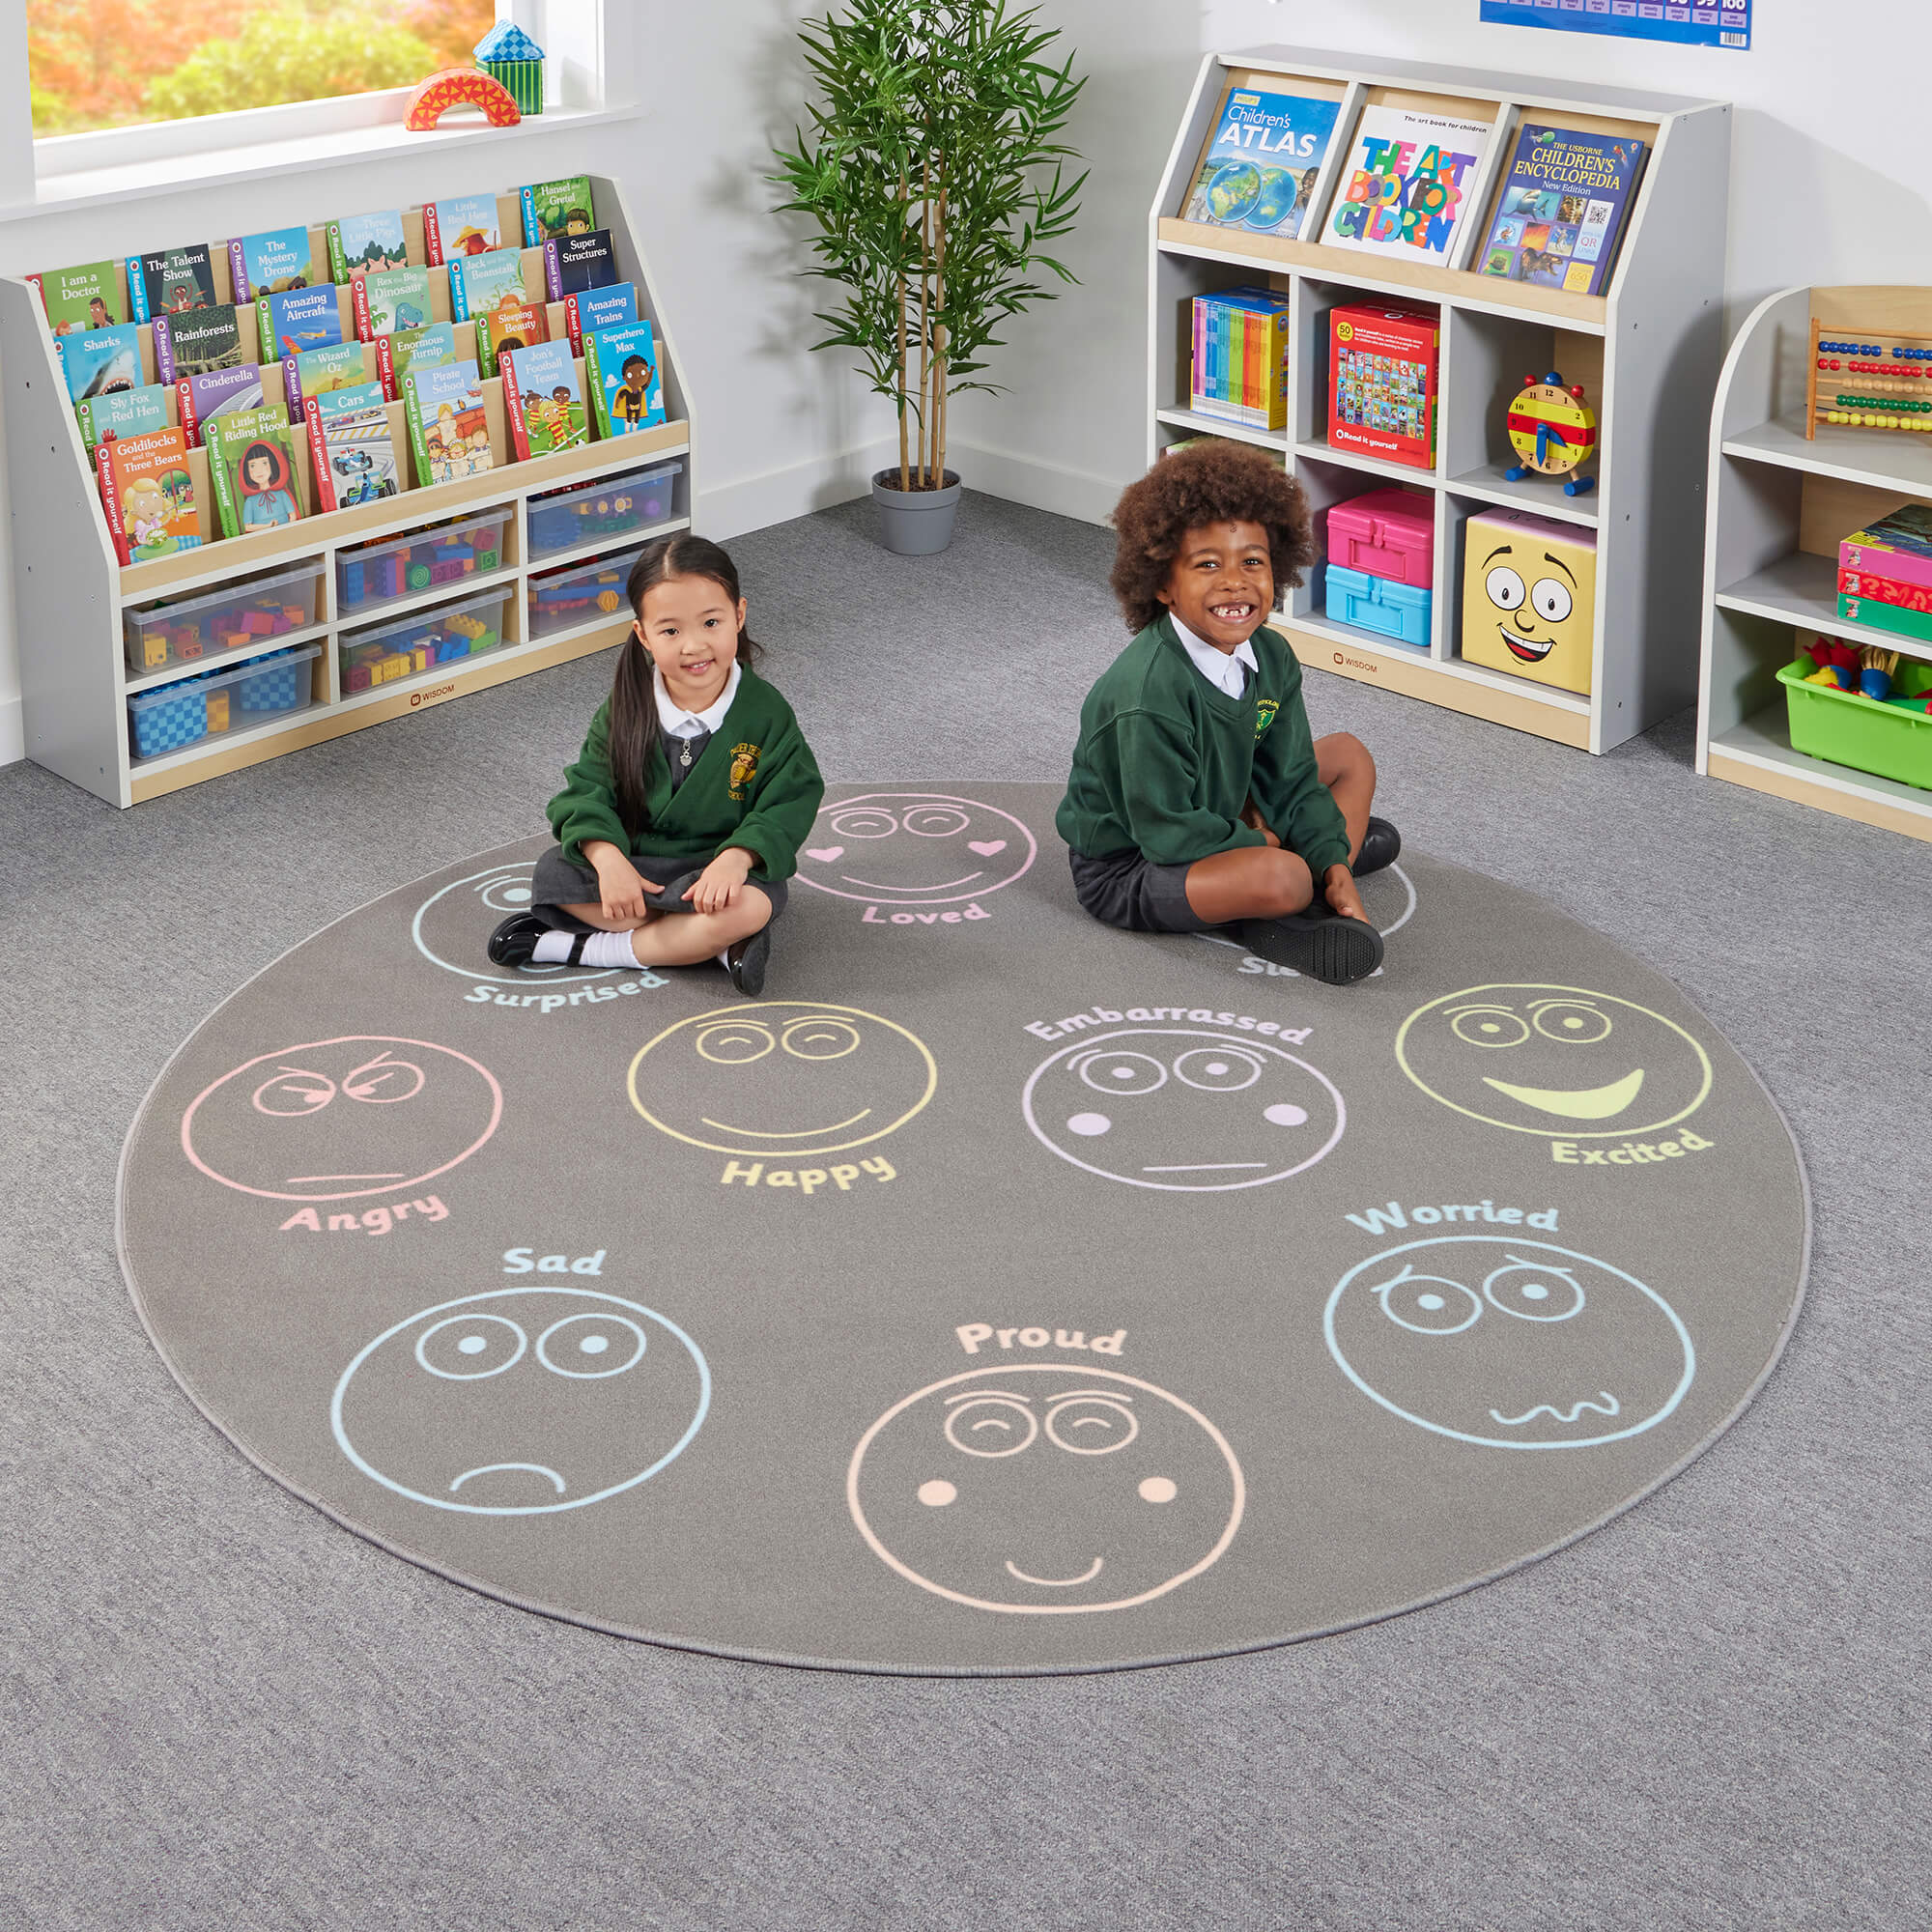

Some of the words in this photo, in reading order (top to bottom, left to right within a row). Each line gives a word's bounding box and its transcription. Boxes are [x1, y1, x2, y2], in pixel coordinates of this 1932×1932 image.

[1228, 105, 1291, 128] Children's
[1460, 124, 1488, 133] children
[1218, 122, 1318, 157] ATLAS
[1553, 142, 1567, 151] THE
[1569, 144, 1604, 156] USBORNE
[1362, 136, 1417, 176] THE
[1412, 145, 1478, 187] ART
[1532, 147, 1615, 174] CHILDREN'S
[1515, 160, 1621, 190] ENCYCLOPEDIA
[541, 183, 570, 196] Hansel
[1345, 170, 1420, 209] BOOK
[1409, 178, 1463, 222] FOR
[1542, 181, 1561, 191] New
[1562, 184, 1591, 195] Edition
[455, 201, 478, 213] Little
[549, 193, 576, 205] Gretel
[448, 213, 466, 224] Red
[429, 218, 439, 240] Read
[265, 242, 286, 253] The
[332, 238, 342, 259] Read
[570, 238, 597, 251] Super
[1580, 237, 1598, 247] QR
[147, 259, 169, 272] The
[171, 253, 205, 267] Talent
[258, 252, 298, 267] Mystery
[466, 259, 486, 270] Jack
[562, 247, 607, 263] Structures
[234, 255, 243, 276] Read
[264, 265, 296, 278] Drone
[471, 263, 515, 280] Beanstalk
[62, 276, 66, 288] I
[70, 276, 87, 286] am
[91, 273, 97, 282] a
[132, 272, 142, 296] Read
[162, 269, 193, 282] Show
[377, 276, 393, 287] Rex
[403, 272, 417, 282] Big
[454, 274, 463, 296] Read
[62, 286, 100, 301] Doctor
[375, 284, 423, 299] Dinosaur
[282, 294, 327, 310] Amazing
[357, 294, 367, 315] Read
[587, 297, 628, 312] Amazing
[286, 306, 326, 322] Aircraft
[498, 311, 533, 325] Sleeping
[594, 311, 623, 326] Trains
[175, 321, 235, 343] Rainforests
[263, 313, 271, 336] Read
[504, 319, 537, 334] Beauty
[1339, 325, 1350, 334] 50
[83, 336, 121, 352] Sharks
[159, 332, 169, 356] Read
[397, 334, 444, 352] Enormous
[603, 328, 645, 344] Superhero
[317, 350, 350, 363] Wizard
[411, 346, 442, 359] Turnip
[530, 349, 554, 360] Jon's
[615, 342, 636, 354] Max
[327, 361, 342, 373] Oz
[381, 352, 390, 373] Read
[526, 359, 563, 375] Football
[199, 371, 253, 390] Cinderella
[289, 372, 298, 394] Read
[433, 369, 460, 383] Pirate
[533, 373, 559, 385] Team
[587, 348, 597, 370] Read
[592, 378, 605, 411] yourself
[432, 379, 465, 395] School
[110, 398, 128, 410] Sly
[129, 394, 149, 404] Fox
[182, 396, 193, 419] Read
[338, 394, 365, 409] Cars
[408, 388, 417, 412] Read
[504, 367, 514, 389] Read
[509, 400, 524, 433] yourself
[112, 411, 133, 423] Red
[136, 405, 159, 417] Hen
[232, 416, 256, 429] Little
[259, 410, 276, 422] Red
[83, 417, 92, 441] Read
[224, 427, 257, 442] Riding
[259, 419, 288, 434] Hood
[309, 413, 319, 437] Read
[117, 435, 177, 456] Goldilocks
[412, 421, 426, 456] yourself
[1345, 430, 1362, 442] Read
[1362, 434, 1368, 444] it
[1369, 438, 1398, 450] yourself
[211, 437, 220, 460] Read
[124, 460, 153, 473] Three
[155, 453, 182, 466] Bears
[313, 446, 329, 482] yourself
[101, 462, 112, 485] Read
[215, 469, 231, 507] yourself
[106, 497, 122, 534] yourself
[1345, 658, 1378, 673] WISDOM
[422, 684, 455, 700] WISDOM
[862, 903, 992, 924] Loved
[464, 970, 669, 1013] Surprised
[1023, 1007, 1314, 1045] Embarrassed
[1551, 1128, 1715, 1165] Excited
[720, 1155, 897, 1195] Happy
[278, 1194, 450, 1236] Angry
[1345, 1201, 1559, 1236] Worried
[502, 1247, 607, 1276] Sad
[954, 1322, 1127, 1356] Proud
